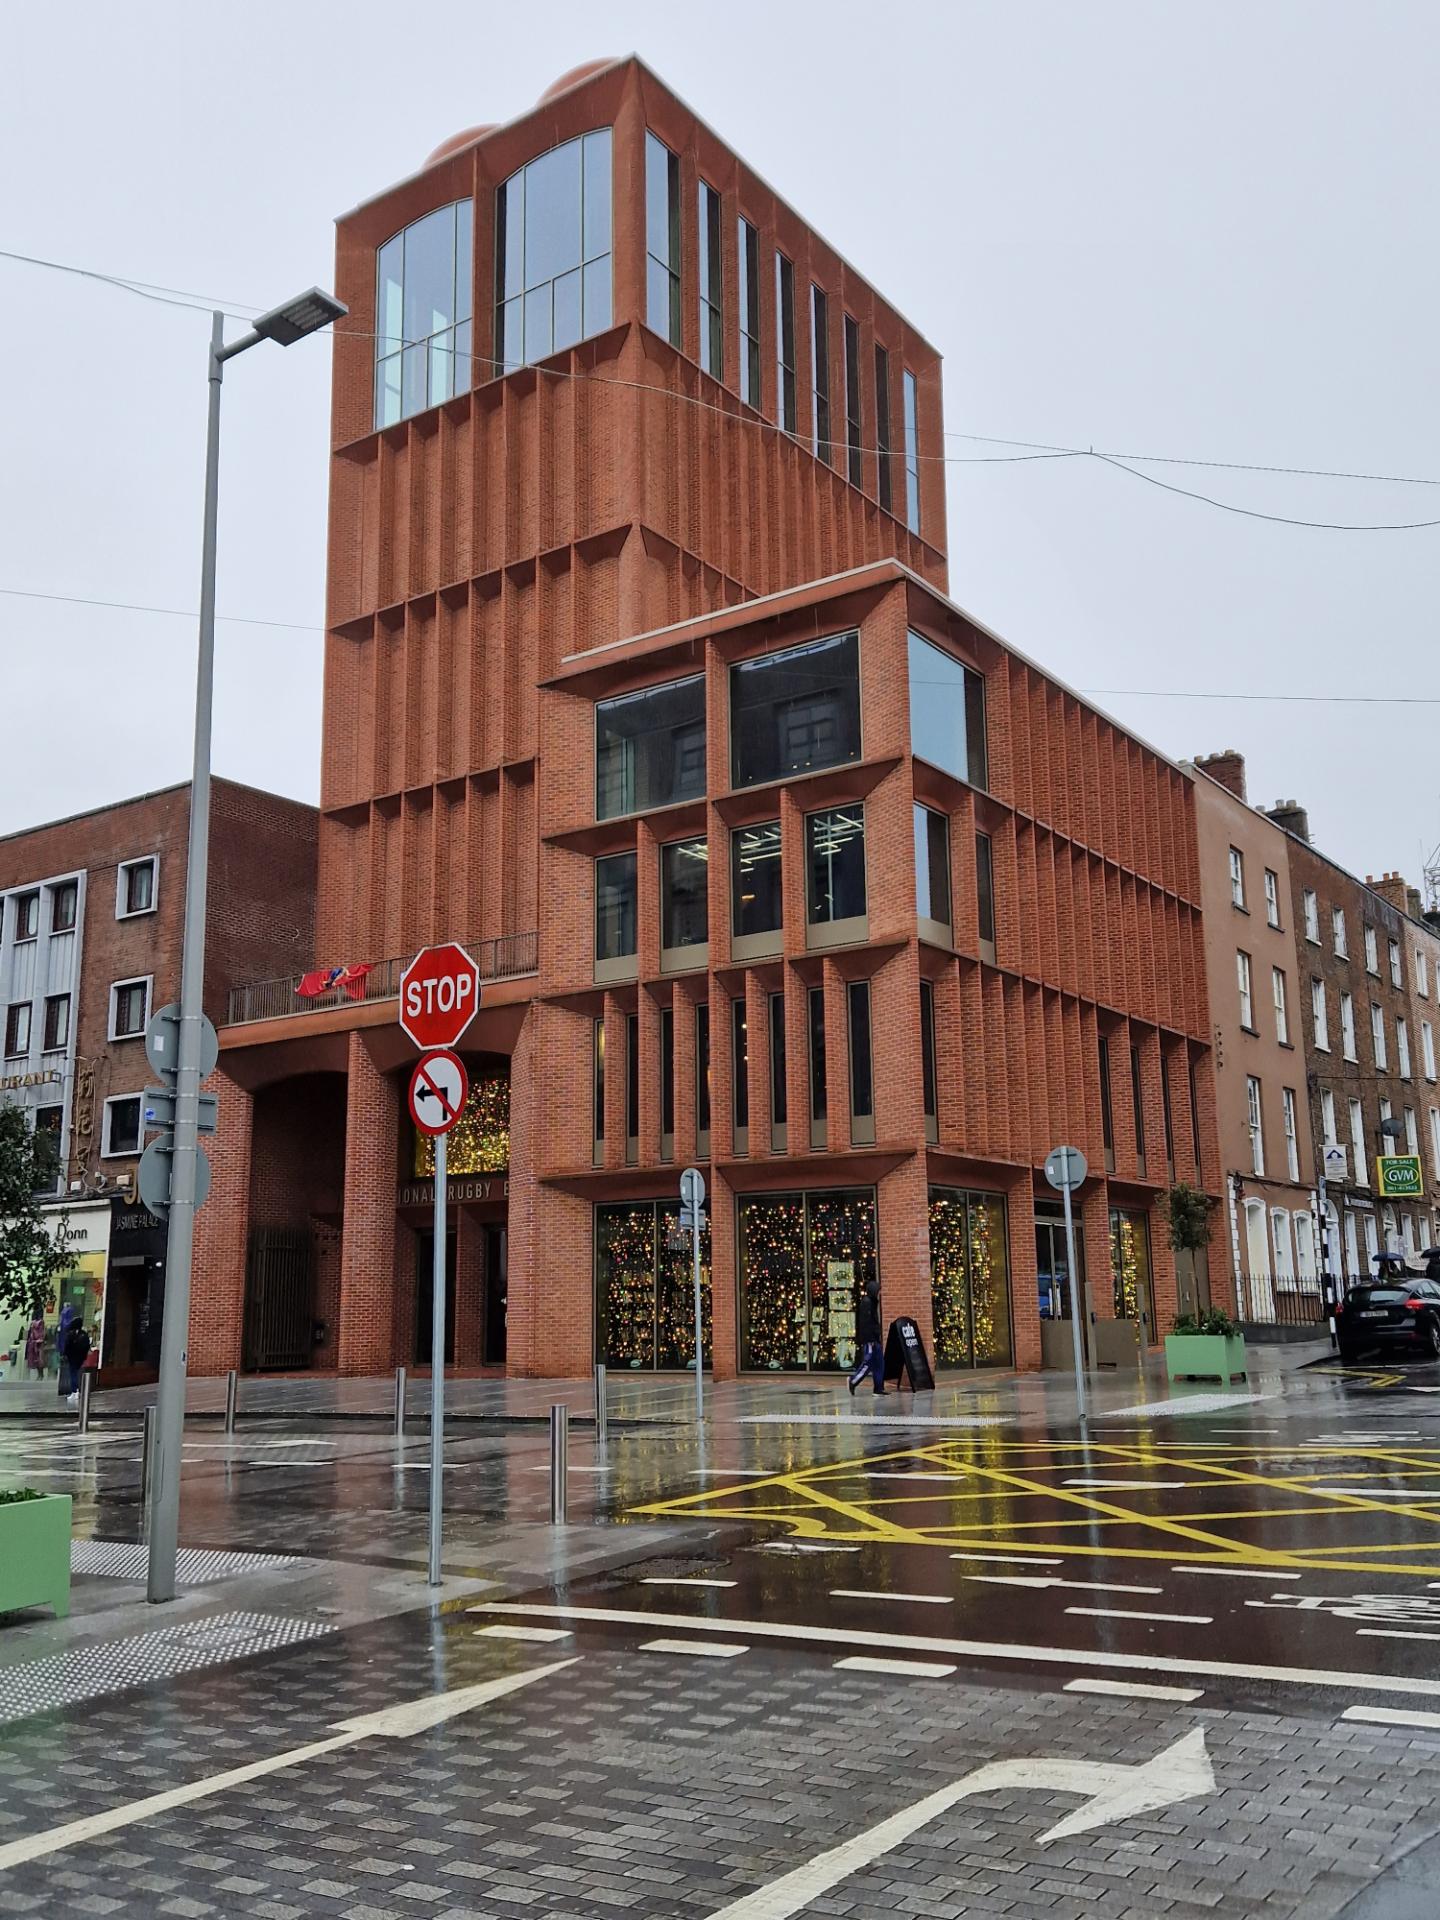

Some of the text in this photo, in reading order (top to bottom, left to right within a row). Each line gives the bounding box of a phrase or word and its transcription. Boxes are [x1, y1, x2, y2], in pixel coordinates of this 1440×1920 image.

[406, 973, 472, 1018] STOP
[1389, 1169, 1414, 1182] GVM
[448, 1181, 491, 1200] RUGBY
[116, 1213, 159, 1230] JASMINE PALACE
[57, 1222, 88, 1242] Donn
